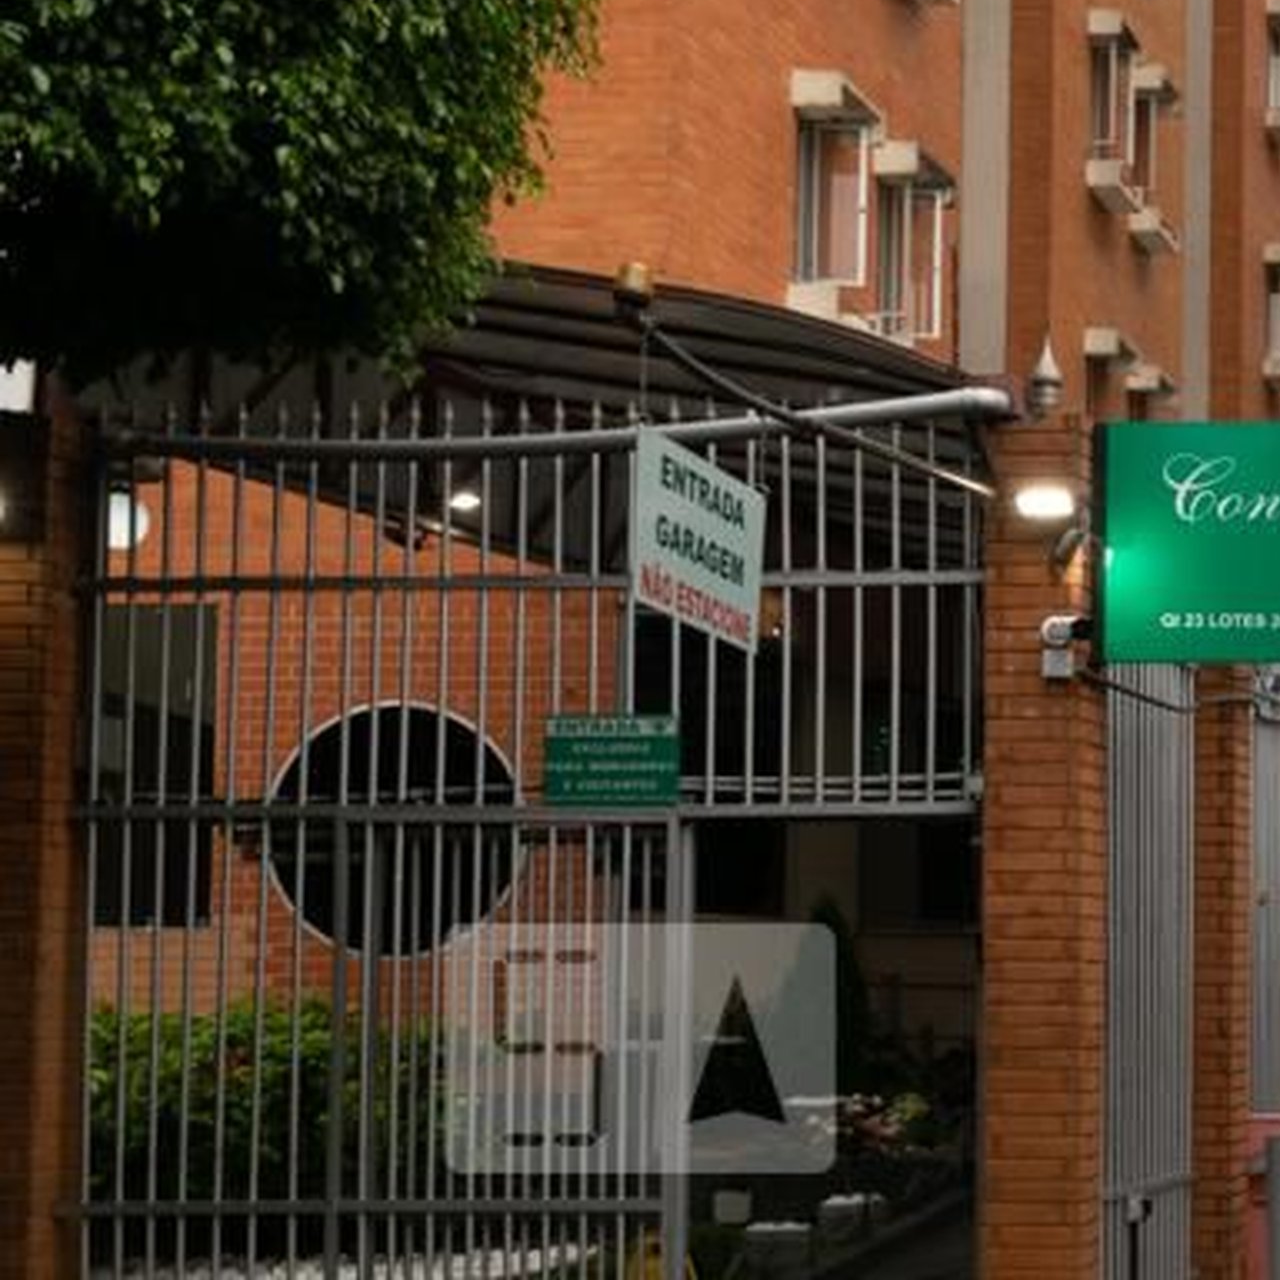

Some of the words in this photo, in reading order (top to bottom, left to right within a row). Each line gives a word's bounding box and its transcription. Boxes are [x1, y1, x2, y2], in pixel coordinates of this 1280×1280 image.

[661, 455, 746, 531] ENTRADA
[655, 515, 745, 587] GARAGEM
[1207, 612, 1268, 629] LOTES
